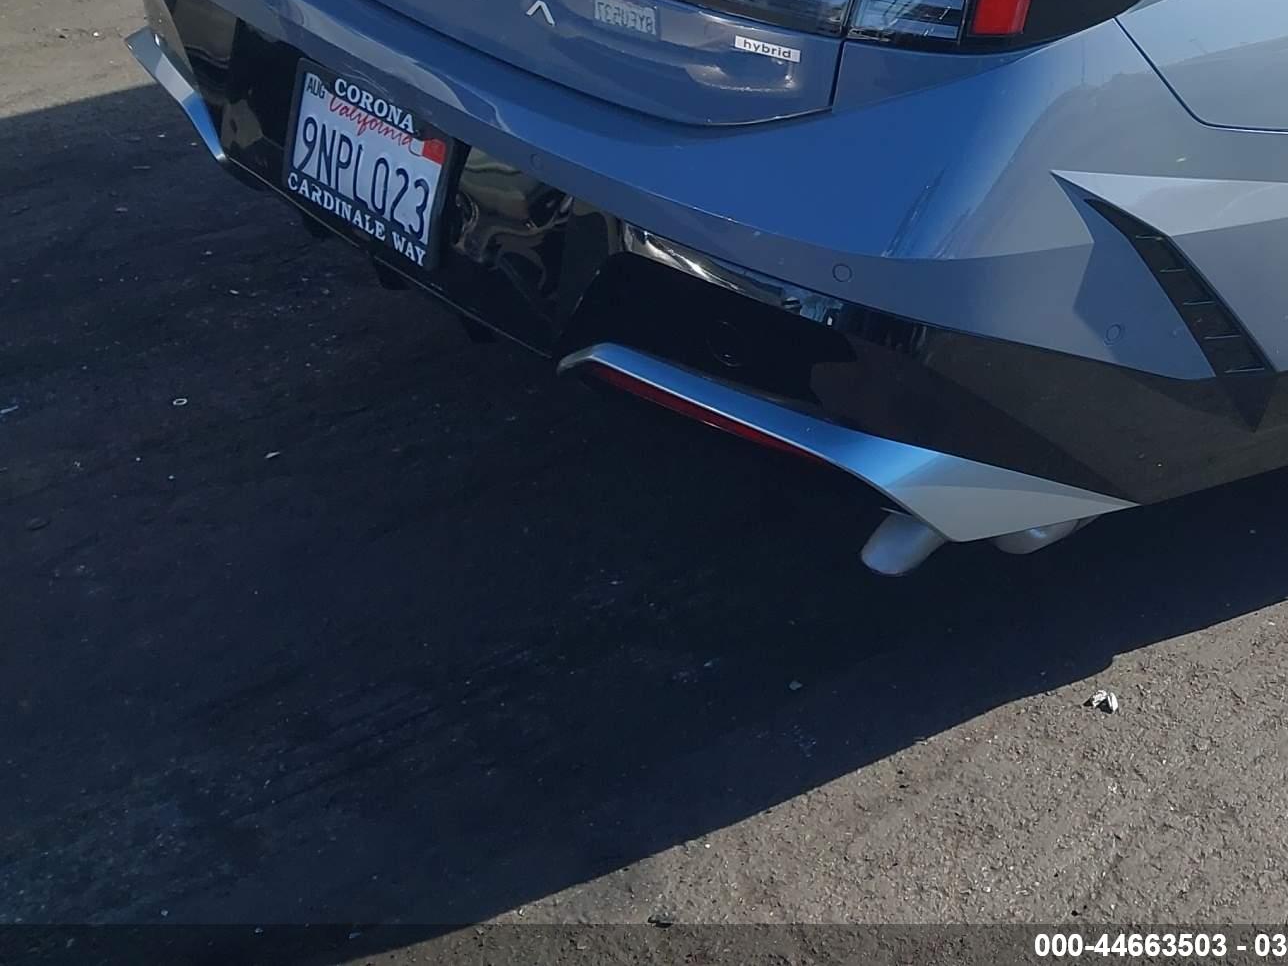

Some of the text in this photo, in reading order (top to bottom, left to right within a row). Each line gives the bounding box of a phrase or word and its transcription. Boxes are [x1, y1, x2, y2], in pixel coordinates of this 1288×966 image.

[742, 38, 792, 60] hybrid
[334, 78, 416, 134] CORONA
[299, 116, 430, 240] 9NPL023
[287, 172, 427, 268] CARDINALE WAY
